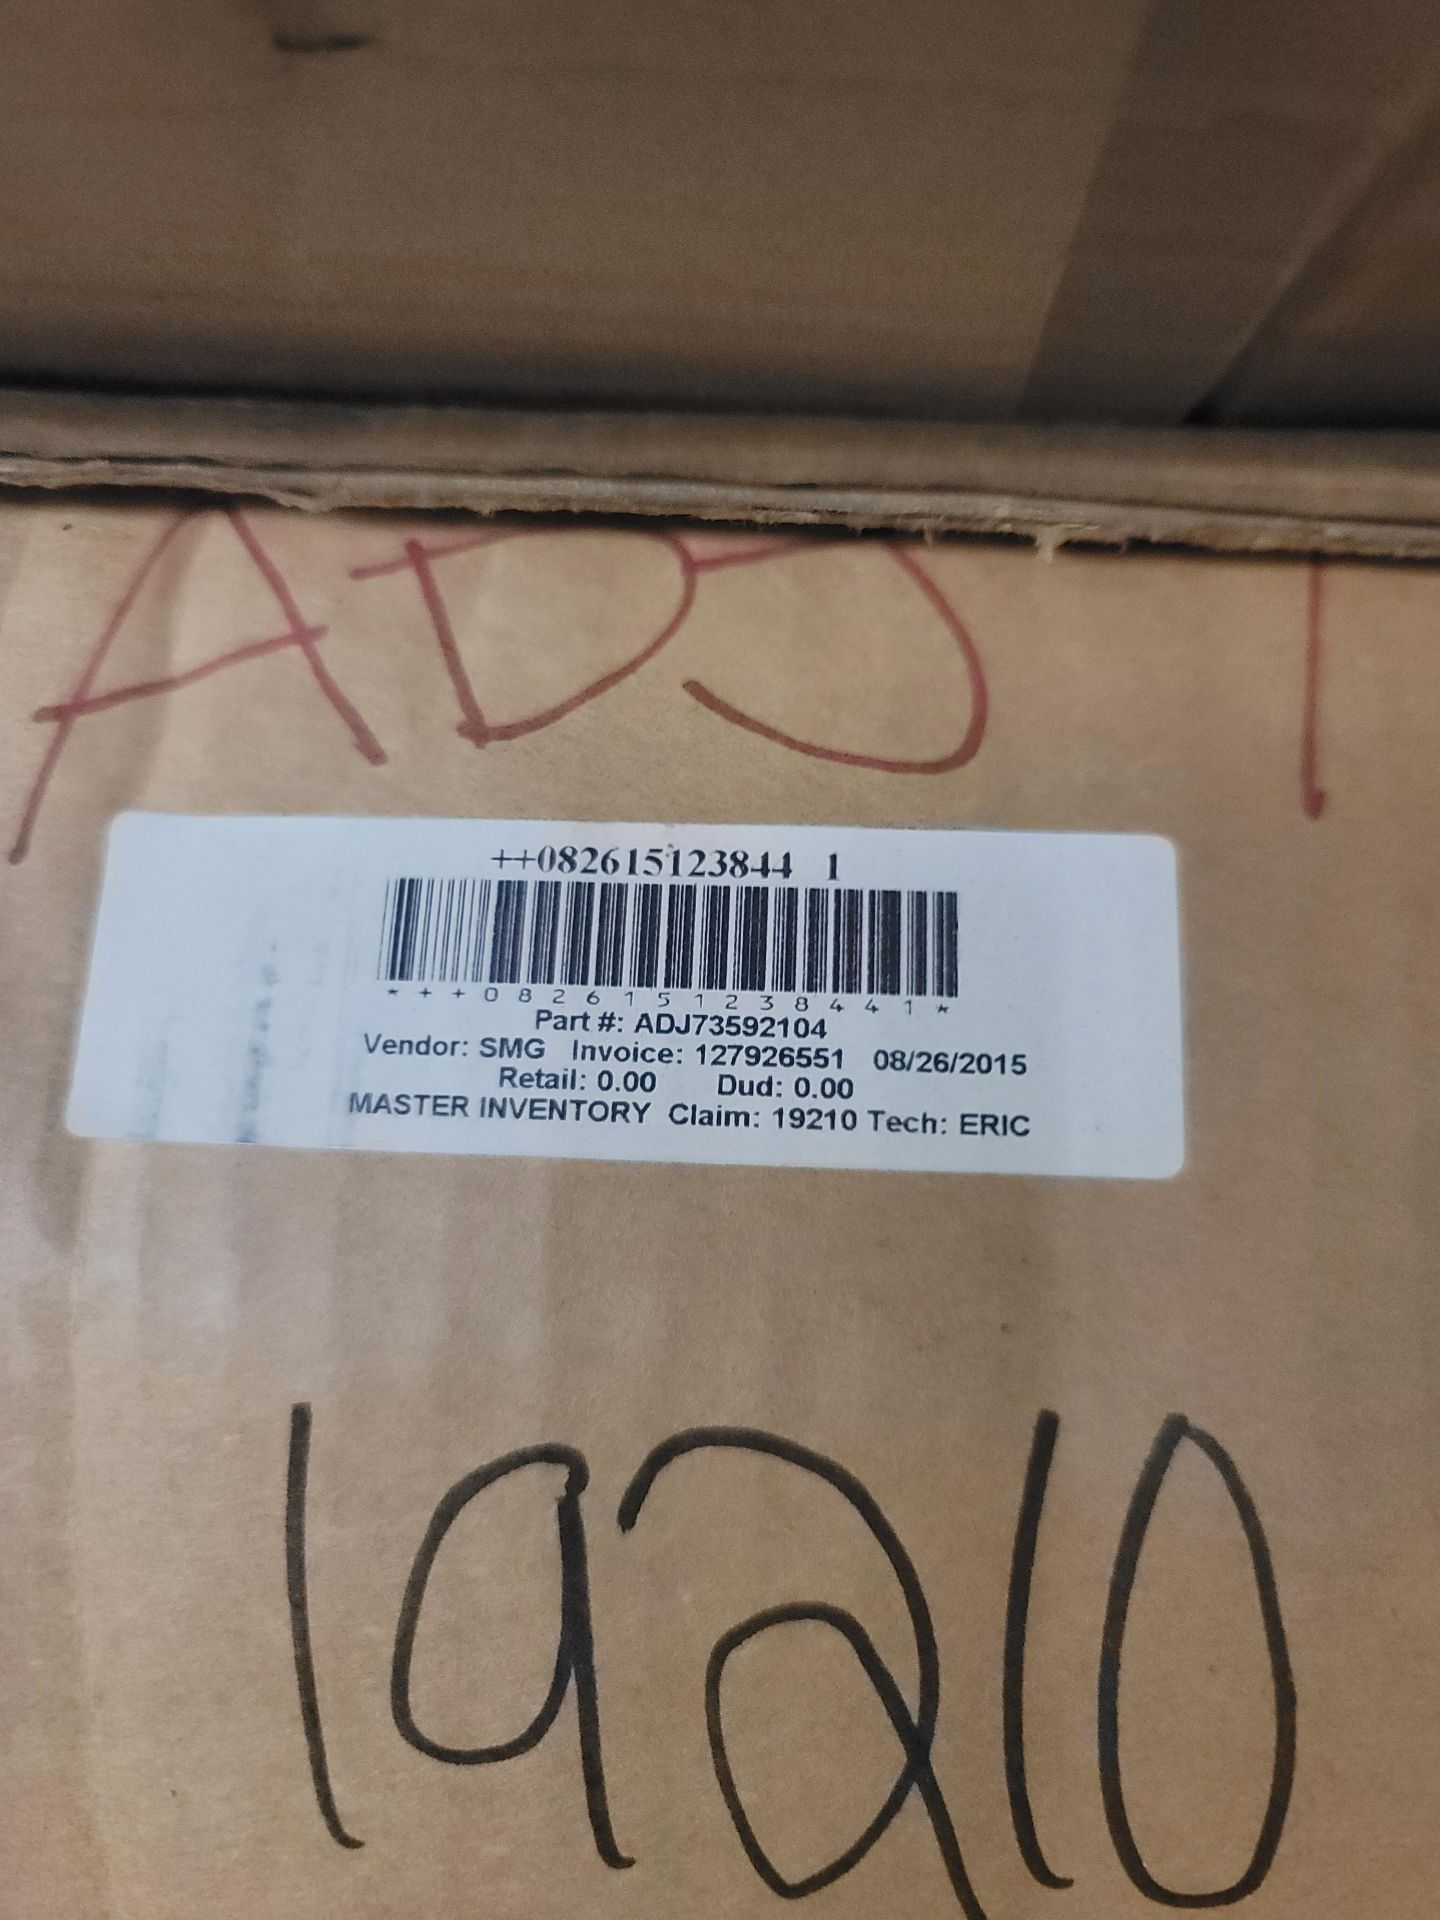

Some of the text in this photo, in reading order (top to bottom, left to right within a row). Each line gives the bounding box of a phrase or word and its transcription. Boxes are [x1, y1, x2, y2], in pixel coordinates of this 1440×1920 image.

[828, 853, 840, 881] 1
[536, 1010, 827, 1039] Part #: ADJ73592104
[364, 1033, 1027, 1076] Vendor: SMG Invoice: 127926551 08/26/2015
[500, 1067, 853, 1099] Retail: 0.00 Dud: 0.00
[350, 1092, 1030, 1137] MASTER INVENTORY Claim: 19210 Tech: ERIC
